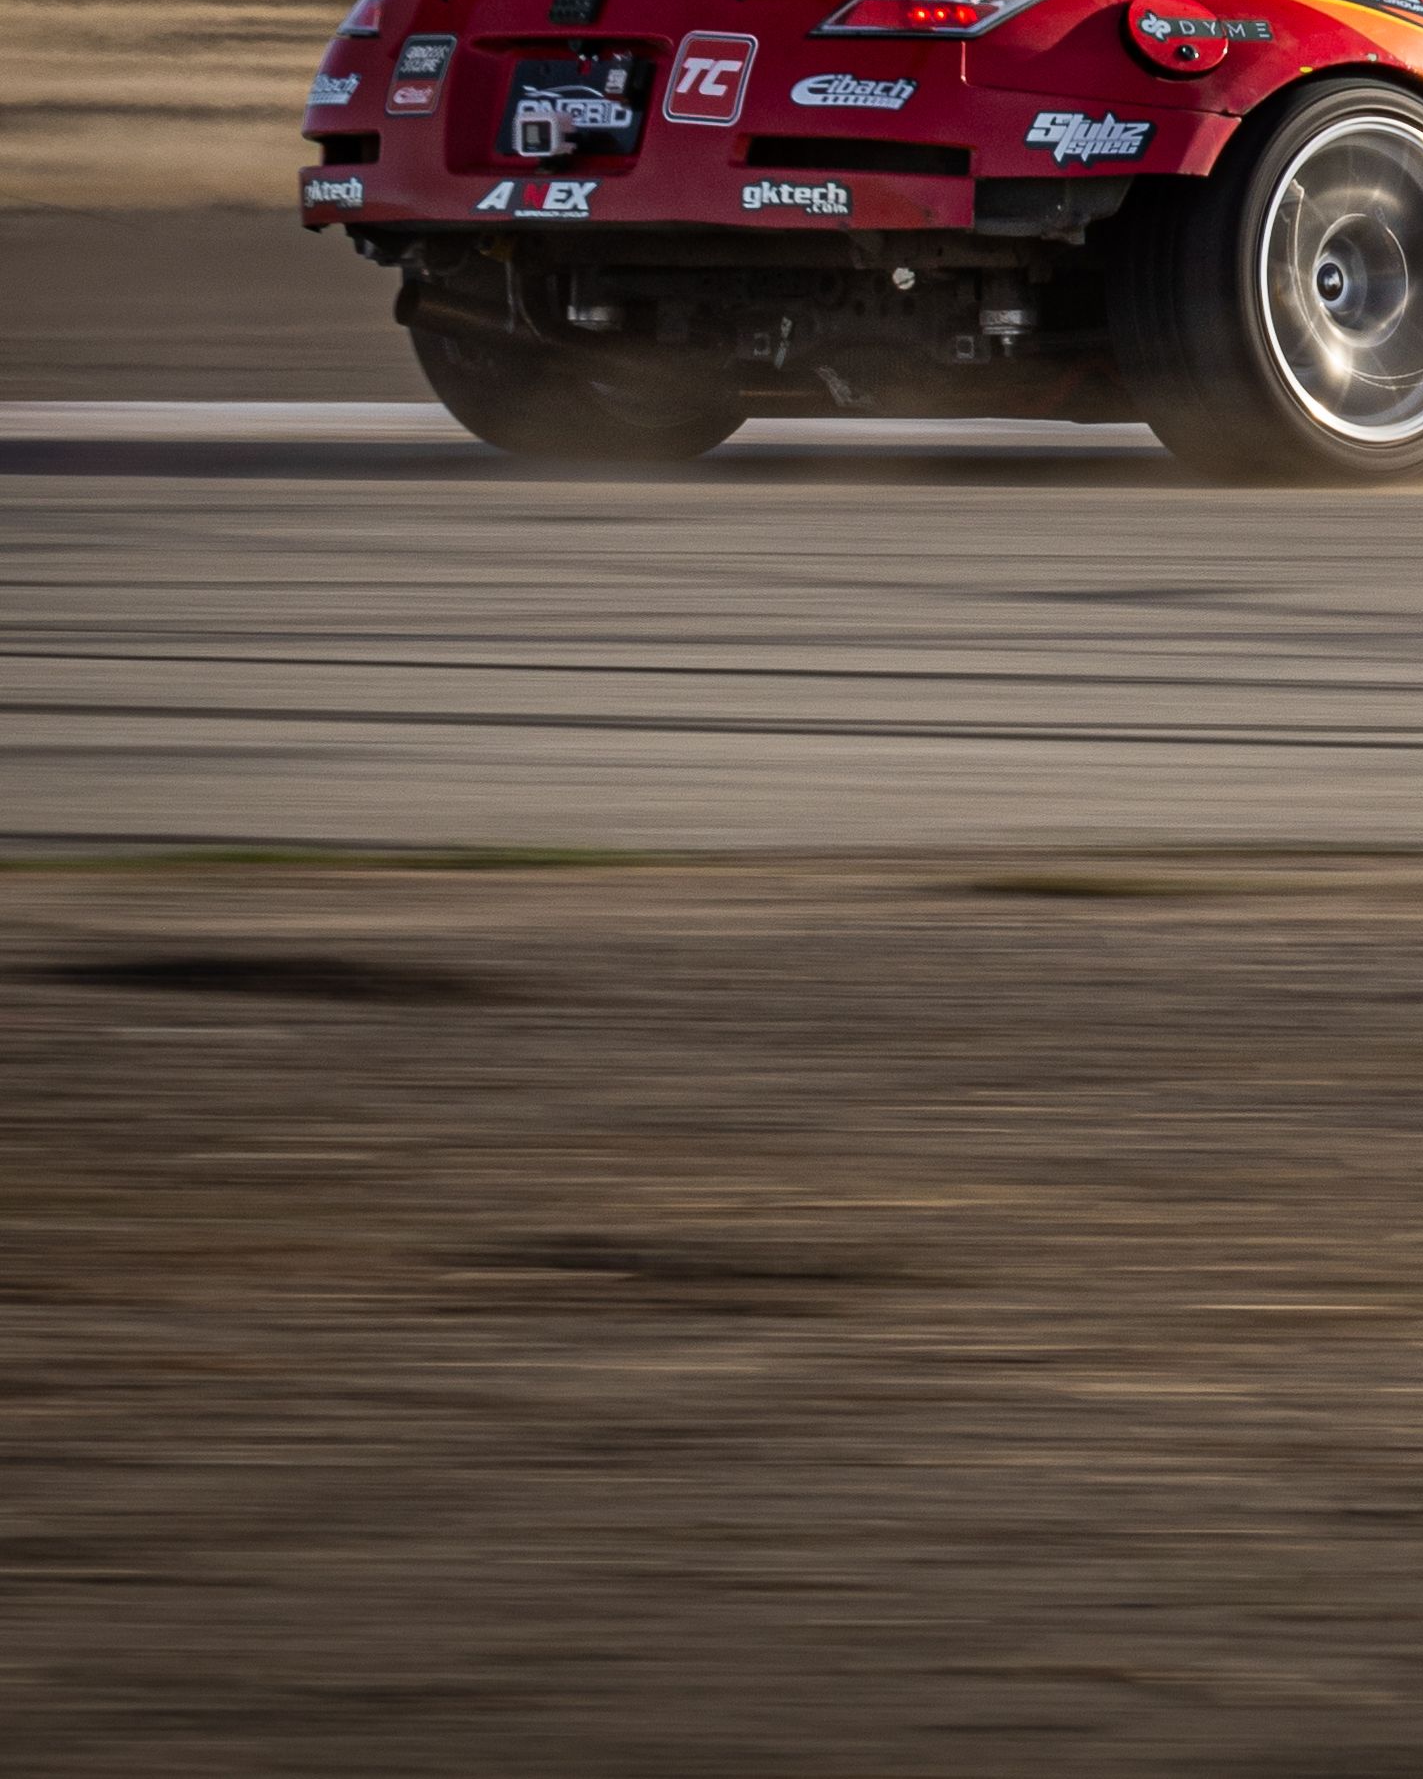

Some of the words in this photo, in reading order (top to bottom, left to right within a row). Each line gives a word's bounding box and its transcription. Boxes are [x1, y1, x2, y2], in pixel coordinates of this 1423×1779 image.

[1179, 20, 1271, 39] DYME
[676, 57, 743, 97] TC
[790, 74, 917, 109] Eibach
[743, 181, 848, 209] gktech
